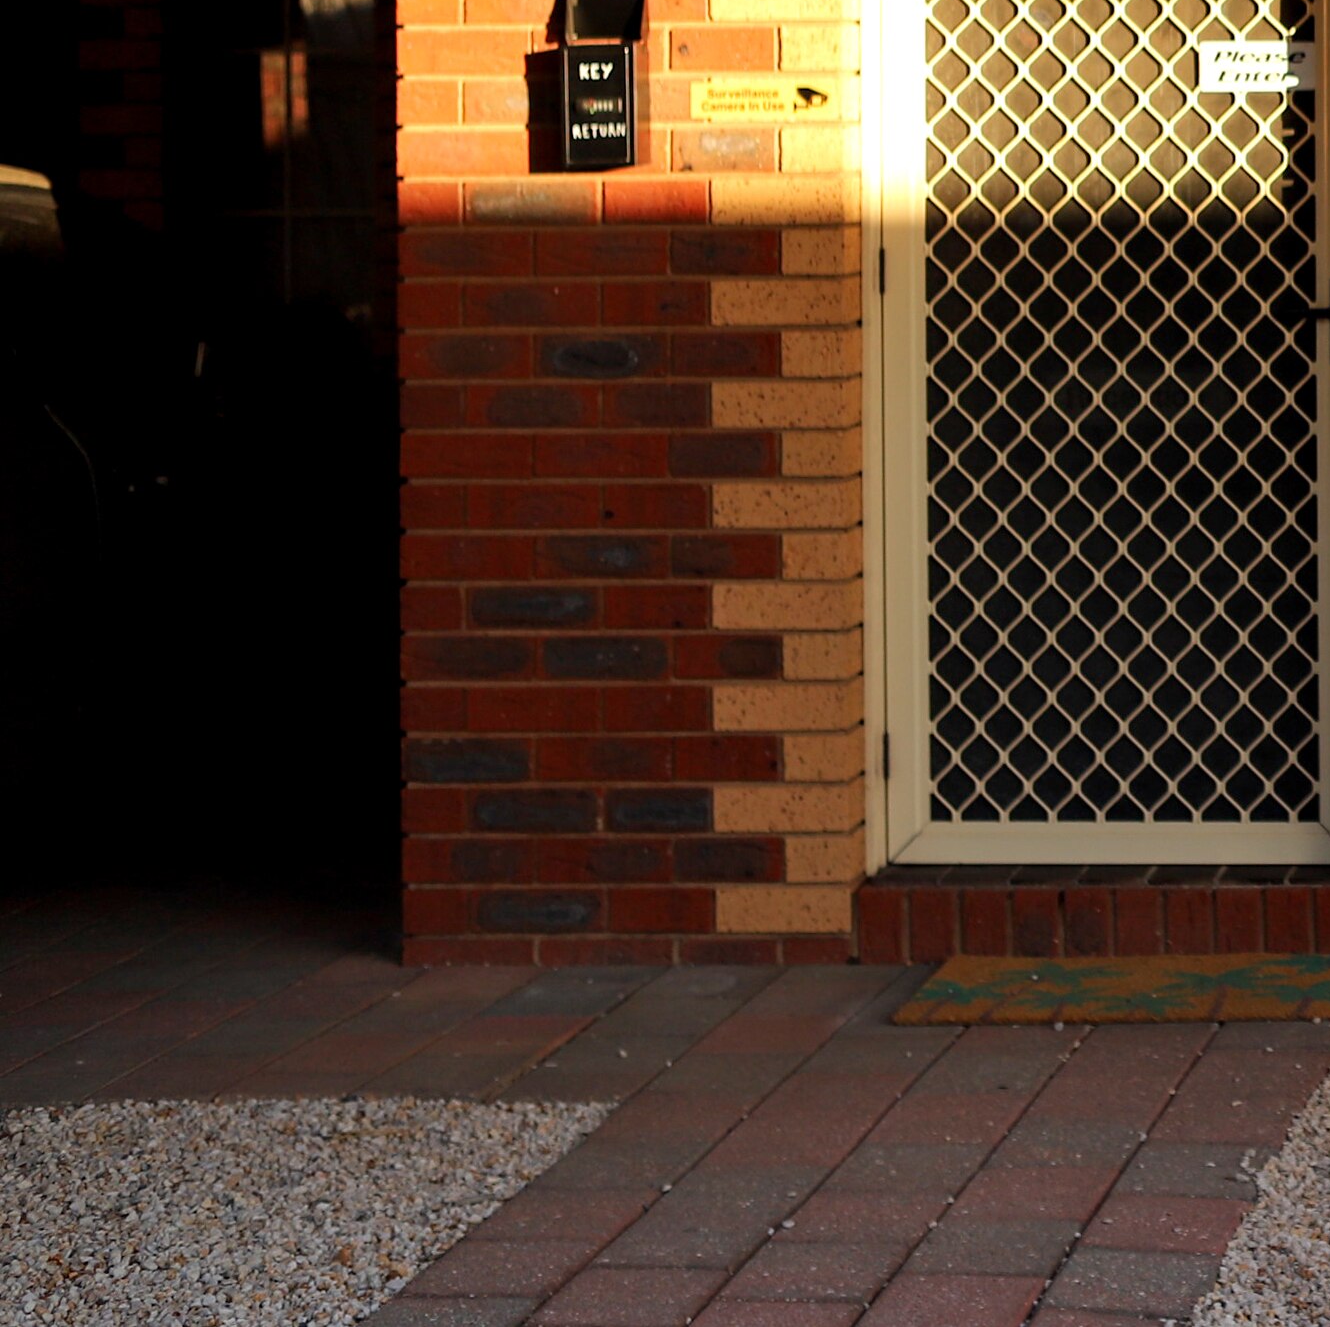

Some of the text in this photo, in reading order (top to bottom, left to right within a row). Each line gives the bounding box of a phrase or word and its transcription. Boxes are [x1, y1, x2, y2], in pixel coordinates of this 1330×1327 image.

[1214, 51, 1306, 64] Please
[579, 62, 614, 81] KEY
[707, 89, 779, 100] Surveillance
[701, 101, 785, 112] Camera In Use
[572, 123, 627, 140] RETURN
